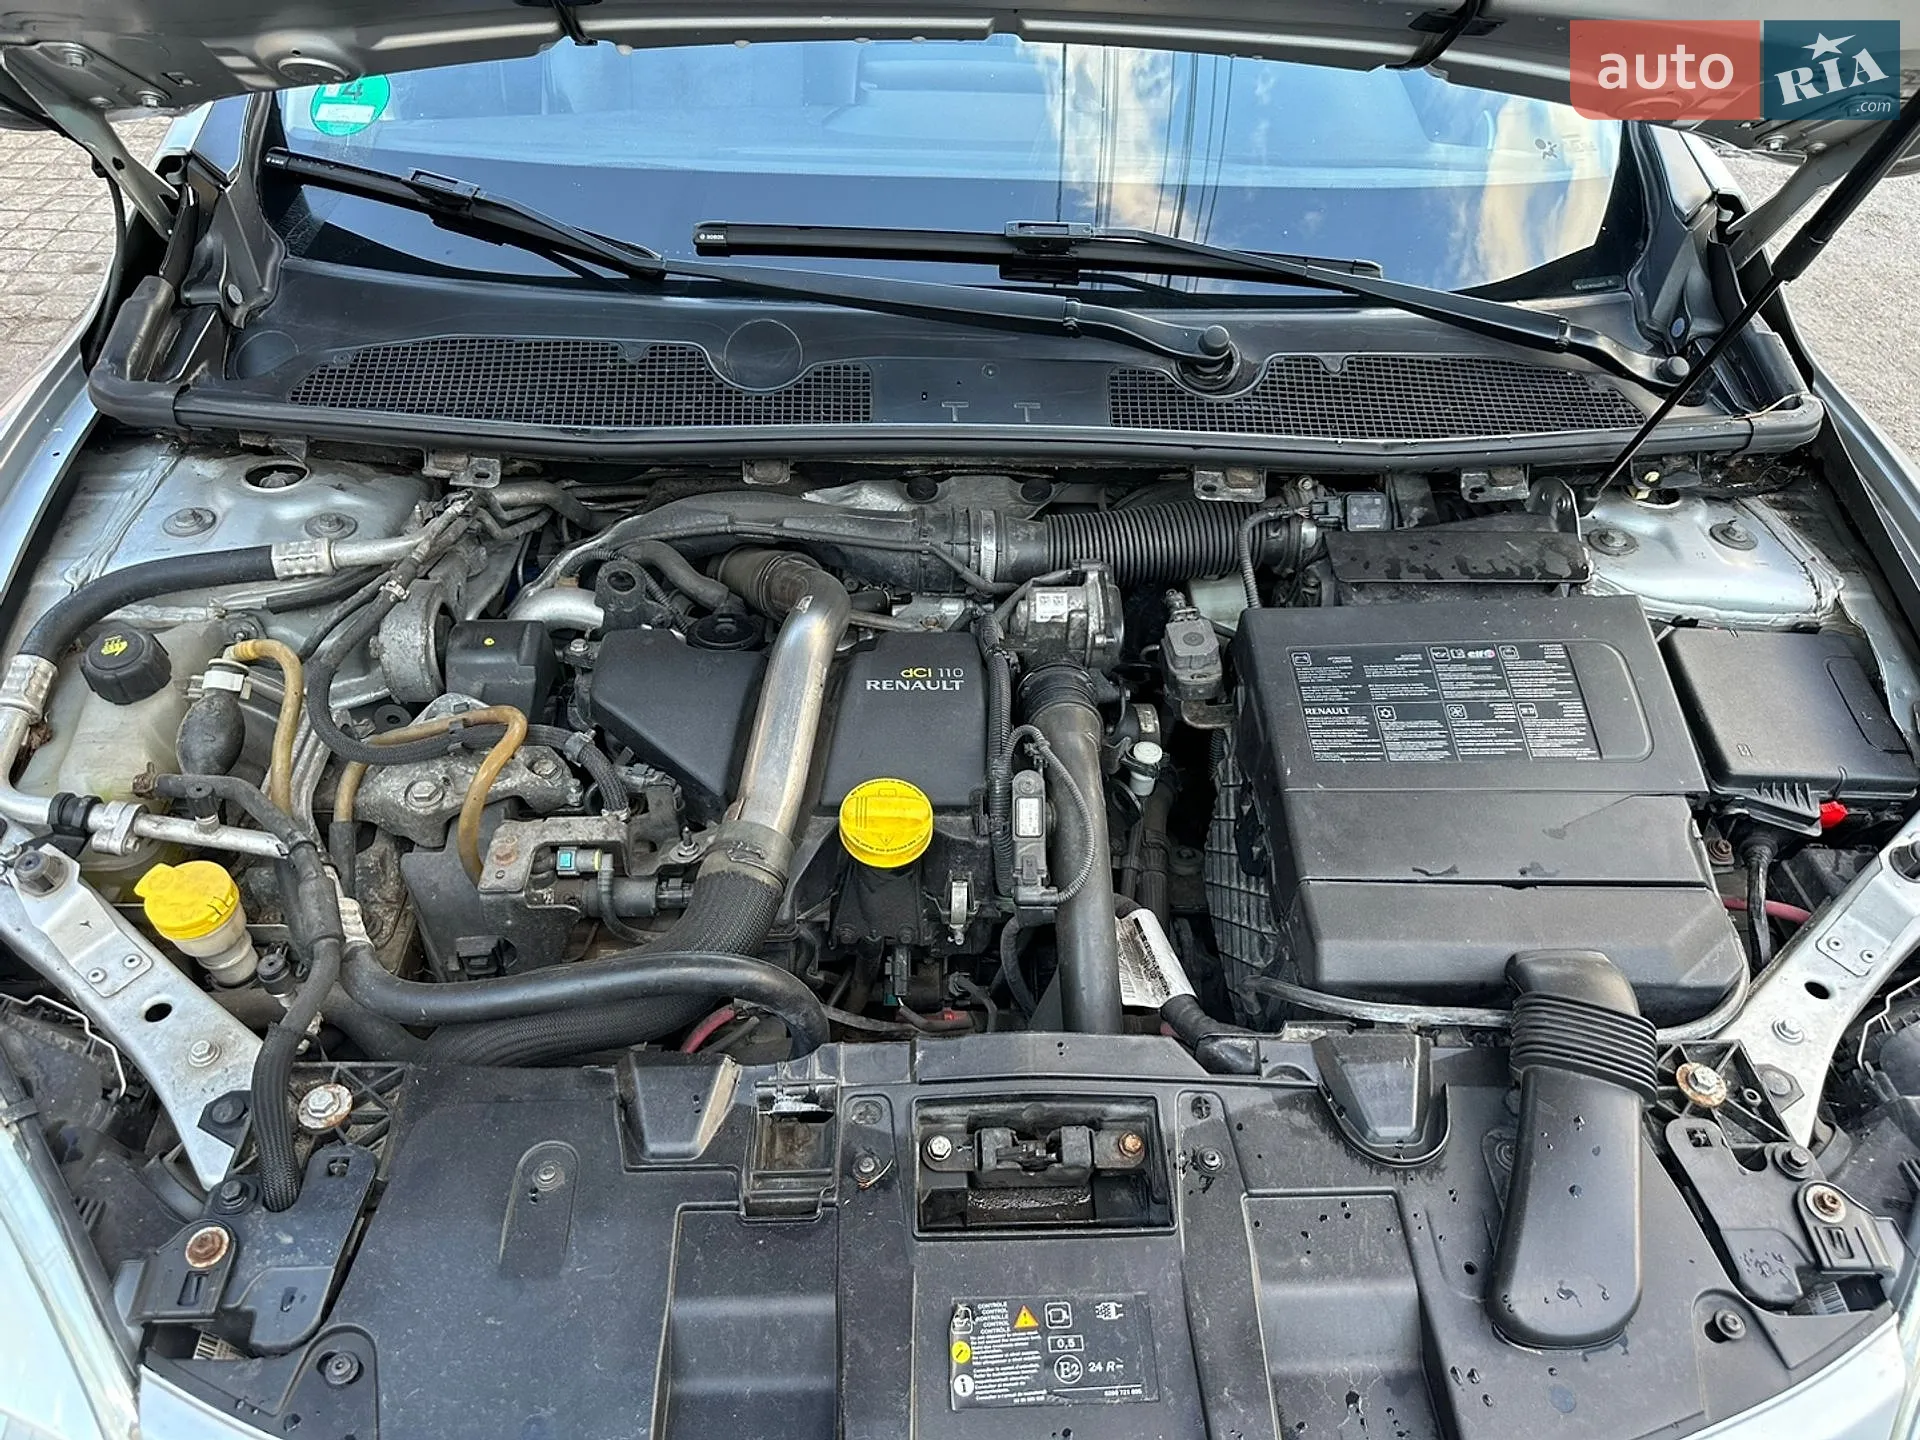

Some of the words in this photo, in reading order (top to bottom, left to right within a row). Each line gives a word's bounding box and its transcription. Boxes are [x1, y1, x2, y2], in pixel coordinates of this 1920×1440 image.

[342, 81, 363, 101] 4
[938, 668, 964, 678] 110
[866, 680, 964, 691] RENAULT
[1304, 706, 1350, 715] RENAULT
[1088, 1361, 1103, 1372] 24
